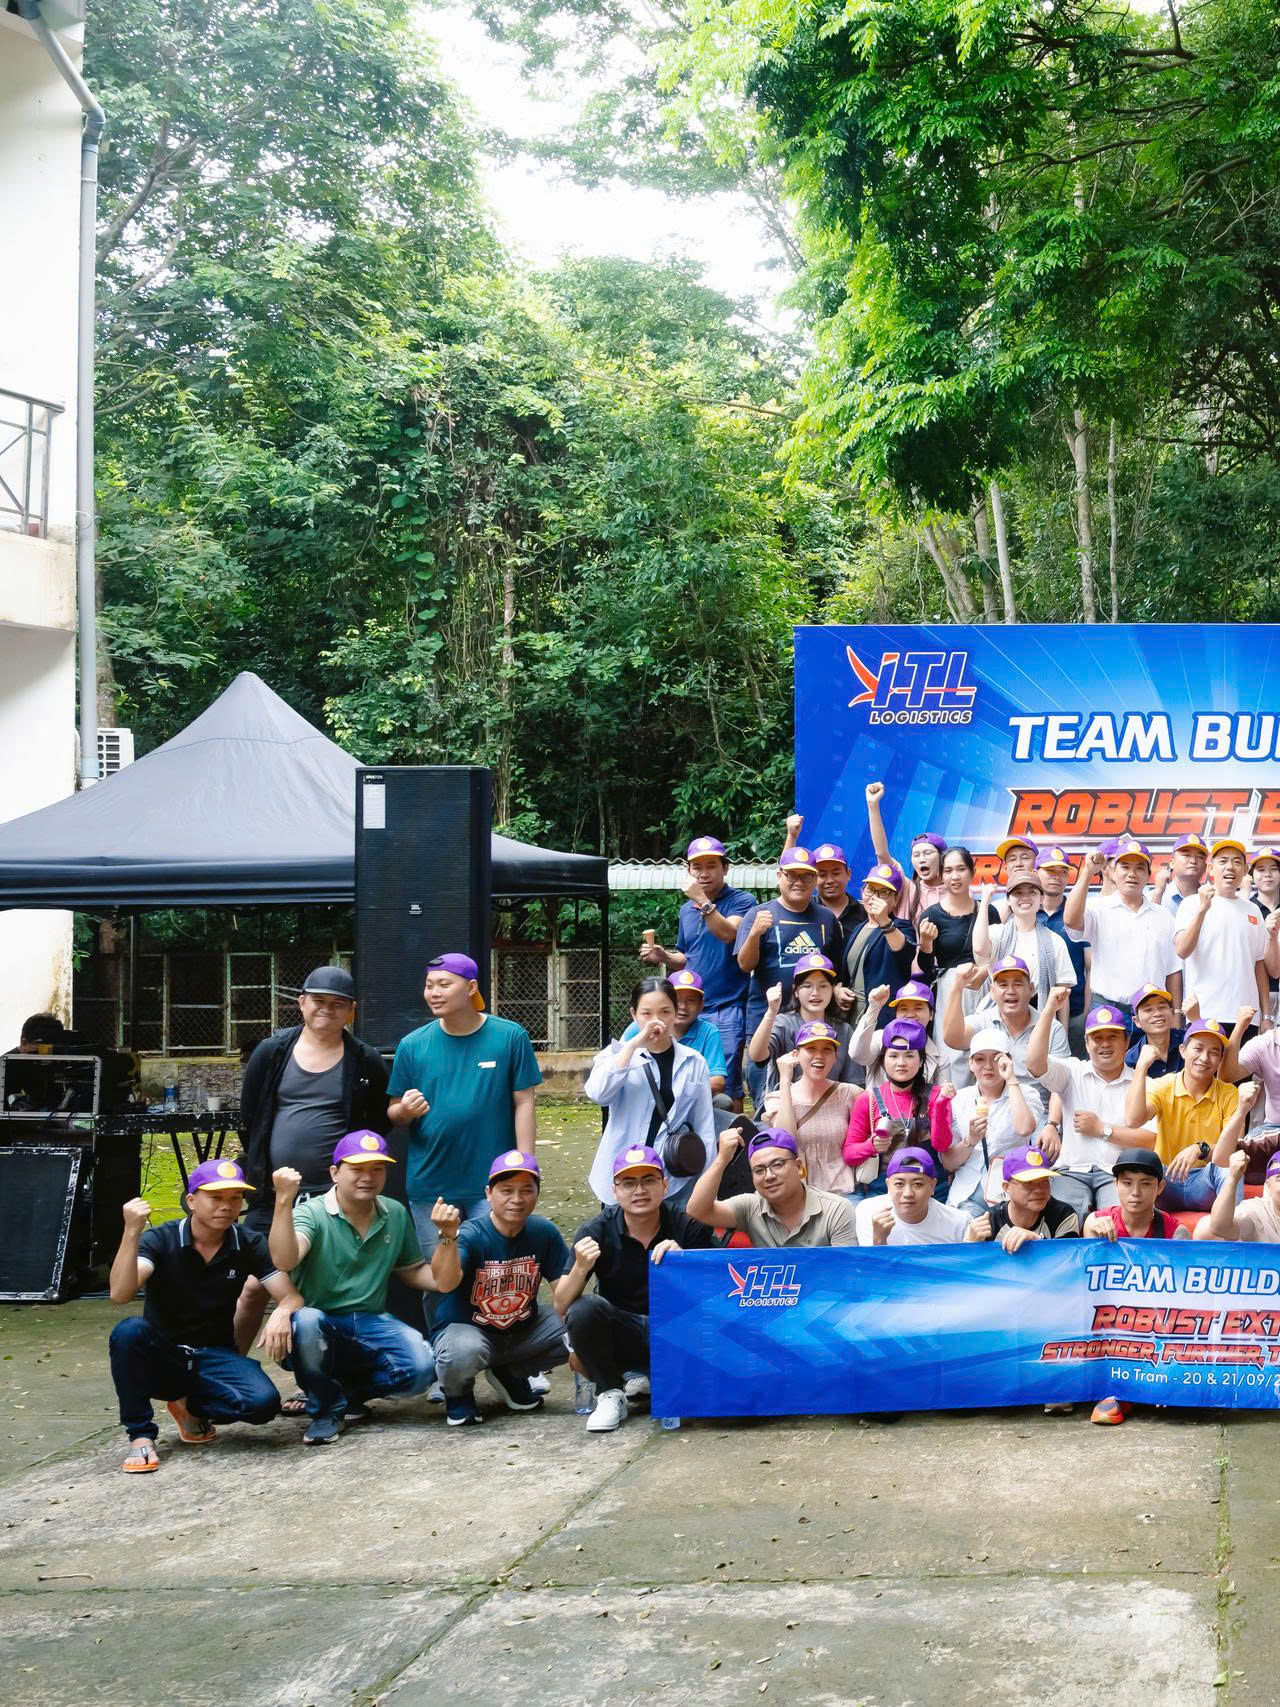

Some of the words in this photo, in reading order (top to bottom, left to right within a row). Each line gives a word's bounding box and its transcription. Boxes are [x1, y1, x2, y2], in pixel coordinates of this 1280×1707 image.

[871, 652, 977, 708] ITL
[869, 710, 973, 725] LOGISTICS
[1008, 714, 1175, 761] TEAM
[1007, 787, 1252, 838] ROBUST
[741, 1265, 801, 1298] ITL
[1086, 1264, 1175, 1293] TEAM
[739, 1298, 799, 1307] LOGISTICS
[1091, 1304, 1222, 1337] ROBUST
[1040, 1340, 1159, 1364] STRONGER,
[1161, 1343, 1265, 1367] FURTHER,
[1111, 1367, 1130, 1380] Ho
[1133, 1368, 1168, 1384] Tram
[1183, 1372, 1202, 1385] 20
[1207, 1372, 1218, 1385] &
